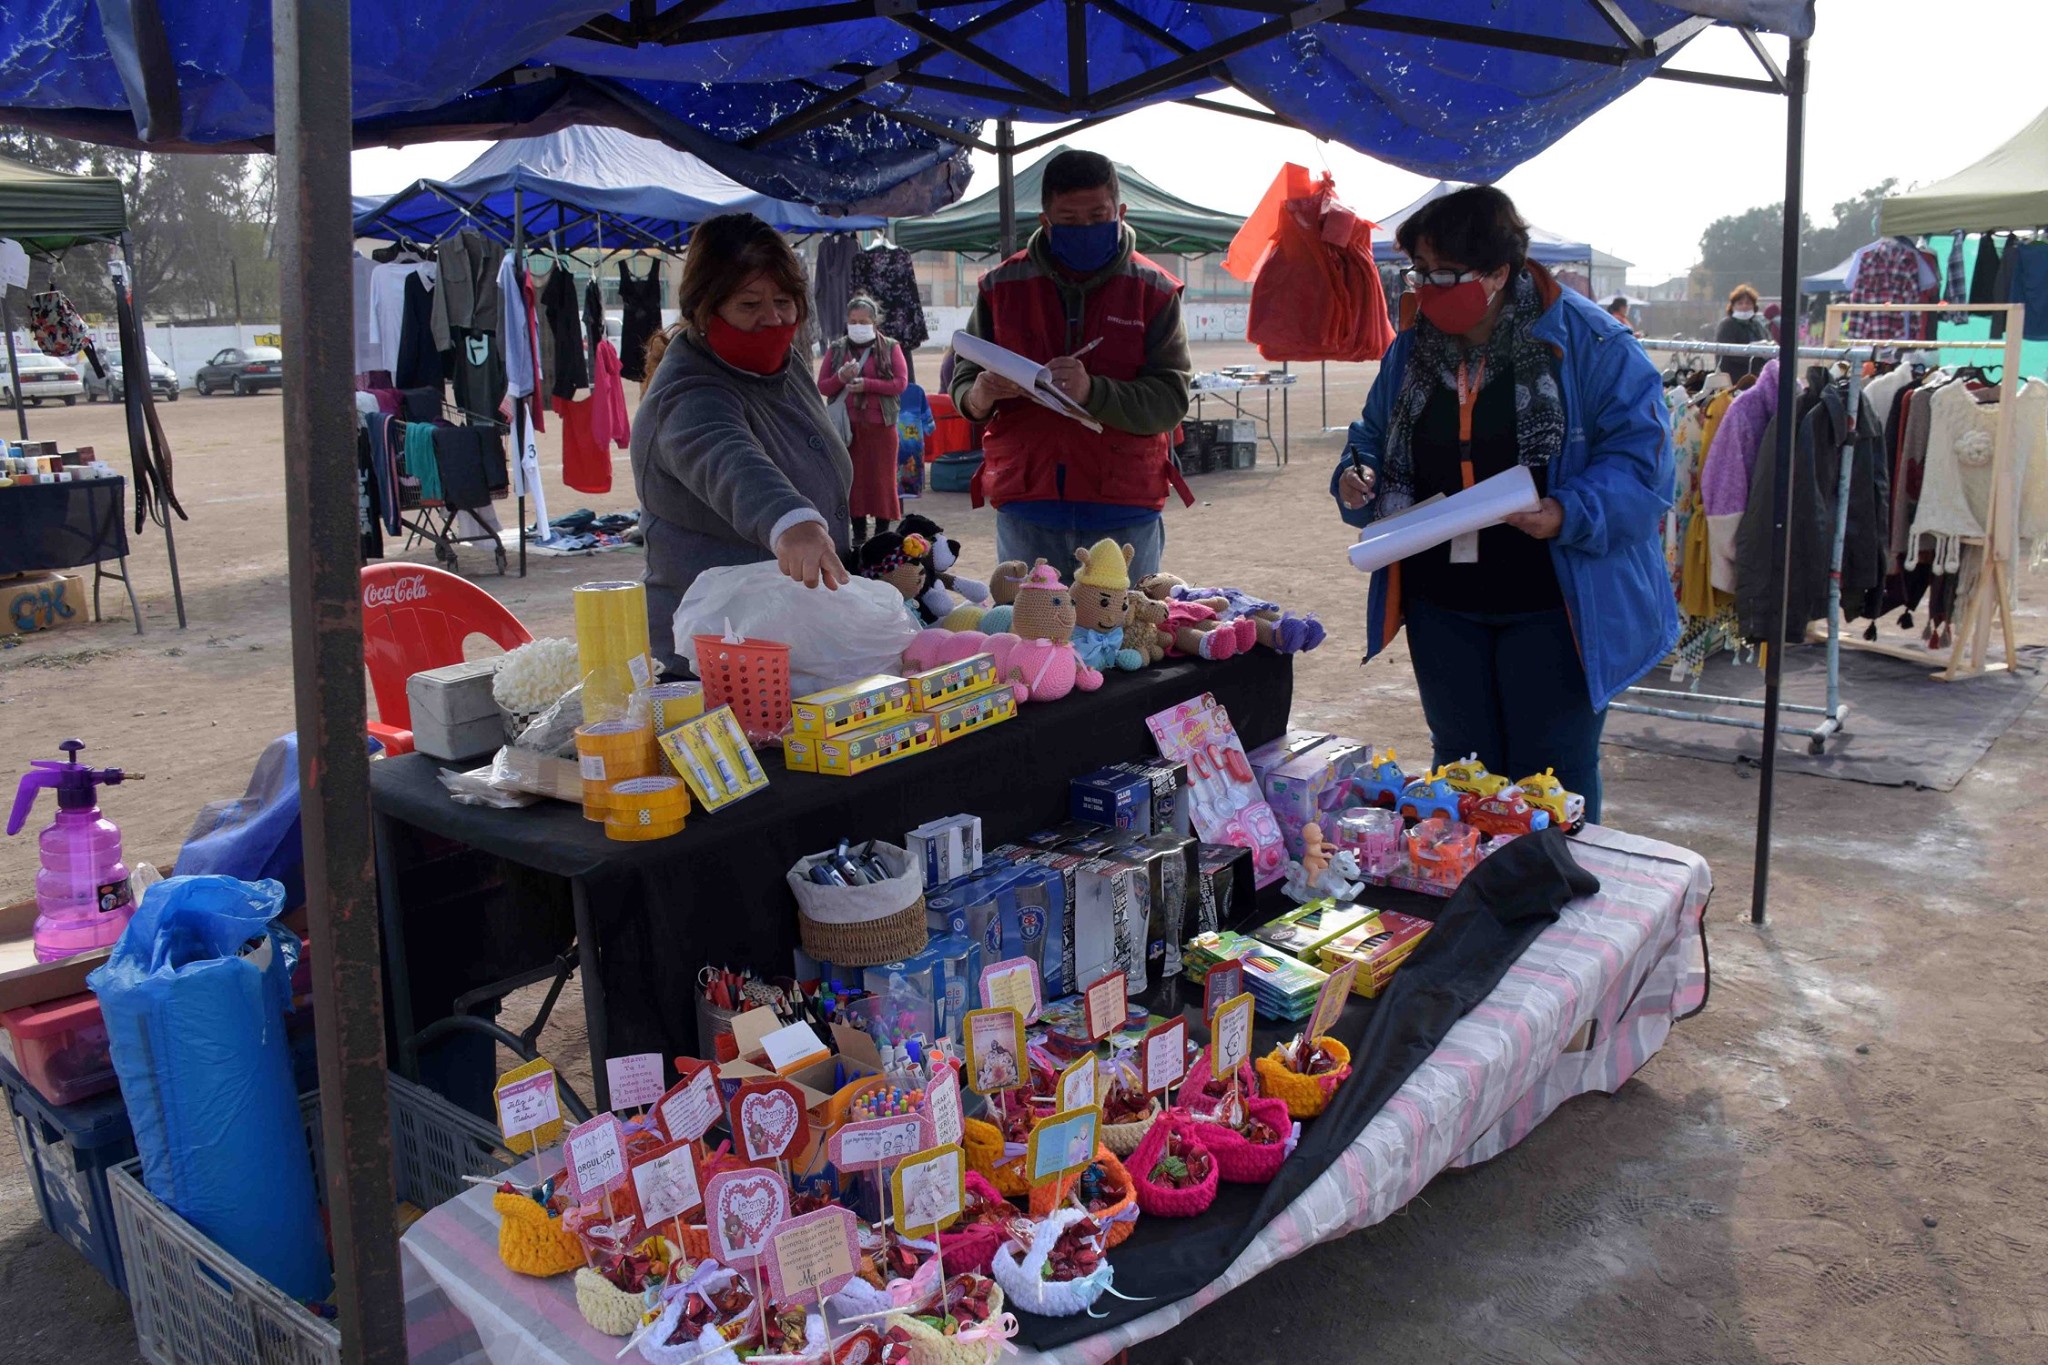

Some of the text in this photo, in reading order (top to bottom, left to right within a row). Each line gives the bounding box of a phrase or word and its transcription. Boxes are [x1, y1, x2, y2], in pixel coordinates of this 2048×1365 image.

[528, 444, 537, 459] 3
[364, 574, 428, 608] Coca-Cola
[577, 1148, 616, 1174] ORGULLOSA
[579, 1167, 598, 1186] DE
[749, 1197, 766, 1209] amo
[786, 1246, 809, 1257] cuenta
[783, 1256, 803, 1267] mejor
[797, 1262, 834, 1287] Mamá
